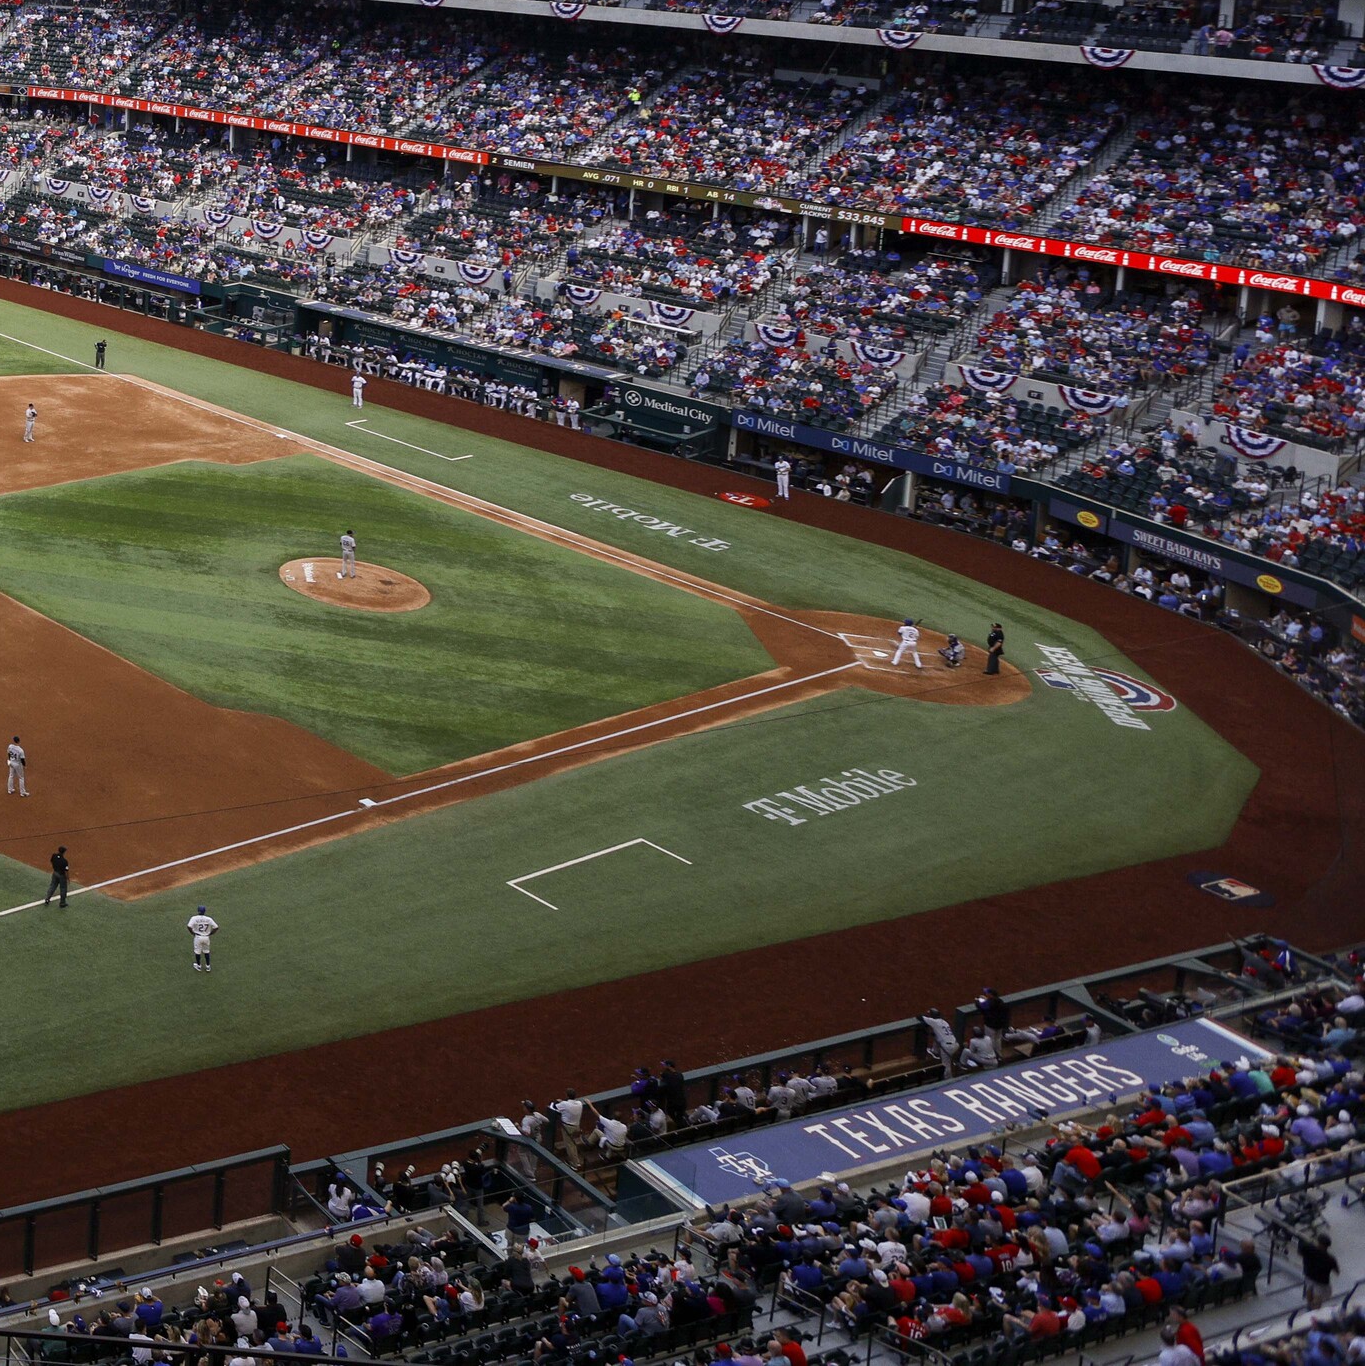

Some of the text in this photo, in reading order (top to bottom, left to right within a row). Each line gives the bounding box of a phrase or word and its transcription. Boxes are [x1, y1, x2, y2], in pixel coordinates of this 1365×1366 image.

[503, 158, 535, 170] SEMIEN
[582, 171, 735, 201] AVG .071 HR 0 RBI 1 AB 14
[798, 210, 885, 226] JACKPOT $33,845
[799, 203, 832, 213] CURRENT
[919, 221, 957, 238] Coca-Cola
[994, 233, 1035, 251] Coca-Cola
[1074, 245, 1117, 263] Coca-Cola
[1159, 259, 1204, 278] Coca-Cola
[1249, 274, 1297, 292] Coca-Cola
[644, 397, 713, 424] Medical City
[757, 417, 795, 439] Mitel
[853, 441, 894, 463] Mitel
[956, 466, 1002, 489] Mitel
[570, 492, 694, 538] Mobile
[1133, 529, 1165, 549] SWEET
[1166, 540, 1194, 559] BABY
[1193, 549, 1221, 570] RAY'S
[1034, 643, 1095, 676] WEEK
[1069, 676, 1151, 730] OPENING
[780, 765, 917, 816] Mobile
[198, 924, 209, 932] 27
[804, 1052, 1145, 1159] TEXAS RANGERS
